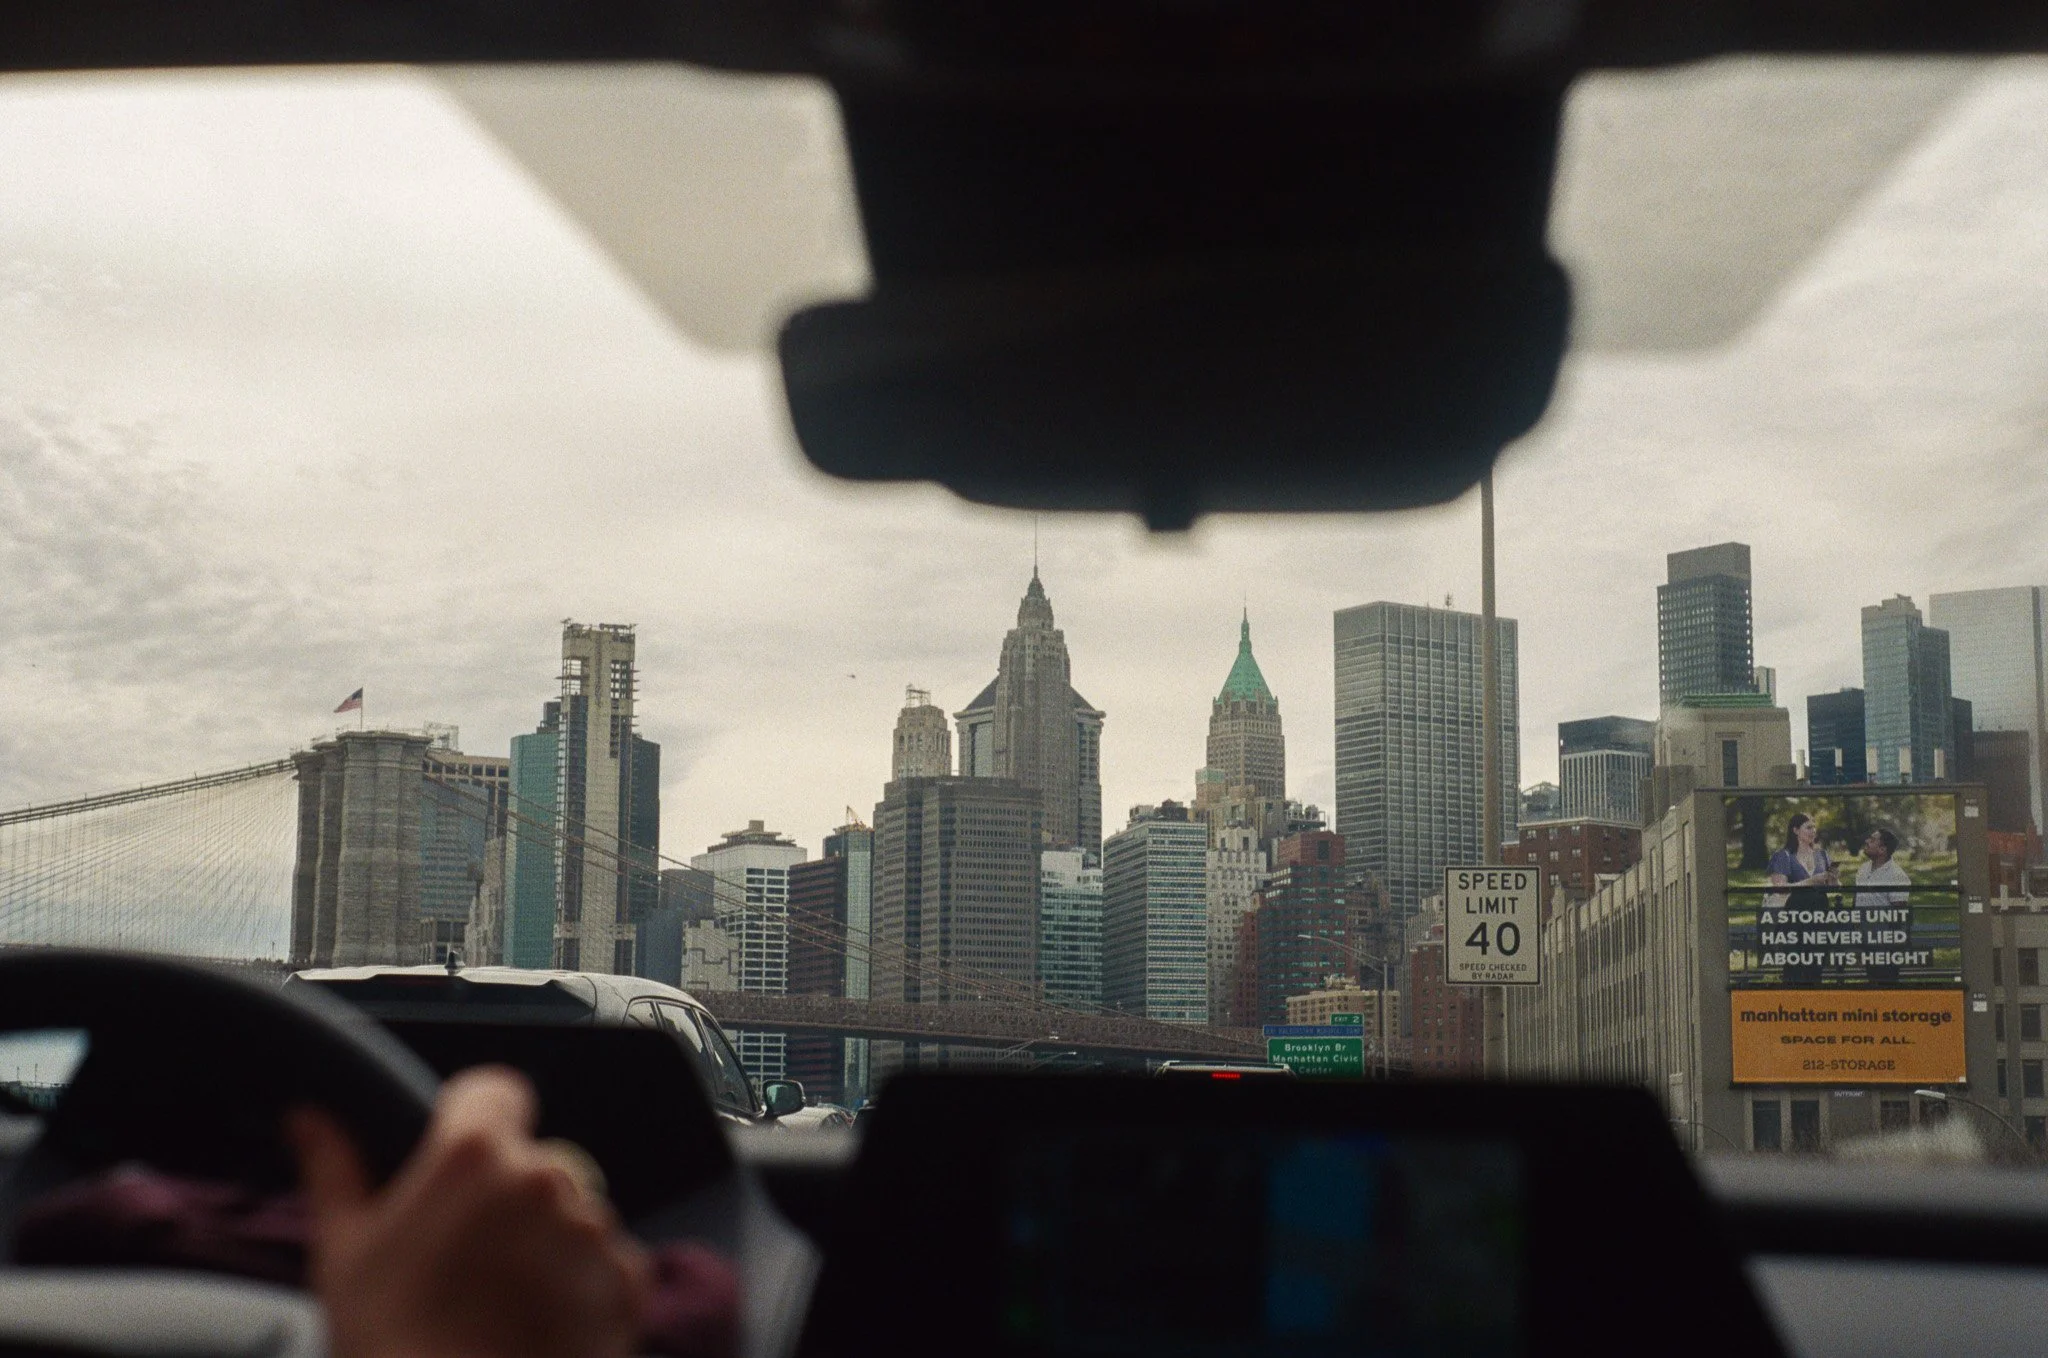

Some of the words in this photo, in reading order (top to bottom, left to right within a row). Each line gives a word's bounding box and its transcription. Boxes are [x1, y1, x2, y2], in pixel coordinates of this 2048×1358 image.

[1458, 873, 1527, 890] SPEED
[1466, 897, 1519, 914] LIMIT
[1761, 911, 1774, 924] A
[1778, 910, 1861, 924] STORAGE
[1866, 909, 1909, 923] UNIT
[1465, 922, 1521, 956] 40
[1761, 931, 1798, 945] HAS
[1803, 931, 1863, 944] NEVER
[1868, 930, 1907, 944] LIED
[1761, 952, 1824, 965] ABOUT
[1830, 952, 1857, 965] ITS
[1861, 951, 1929, 965] HEIGHT
[1459, 963, 1486, 971] SPEED
[1489, 963, 1527, 972] CHECKED
[1471, 972, 1483, 980] BY
[1485, 972, 1514, 981] RADAR
[1352, 1015, 1360, 1024] 2
[1740, 1004, 1838, 1022] manhattan
[1842, 1009, 1878, 1022] mini
[1882, 1009, 1952, 1026] storage
[1781, 1035, 1837, 1045] SPACE
[1841, 1035, 1875, 1045] FOR
[1284, 1043, 1331, 1053] Brooklyn
[1335, 1043, 1347, 1052] Br
[1272, 1054, 1329, 1063] Manhattan
[1333, 1054, 1359, 1063] Civic
[1298, 1066, 1333, 1074] Center
[1802, 1059, 1896, 1071] 212-STORAGE
